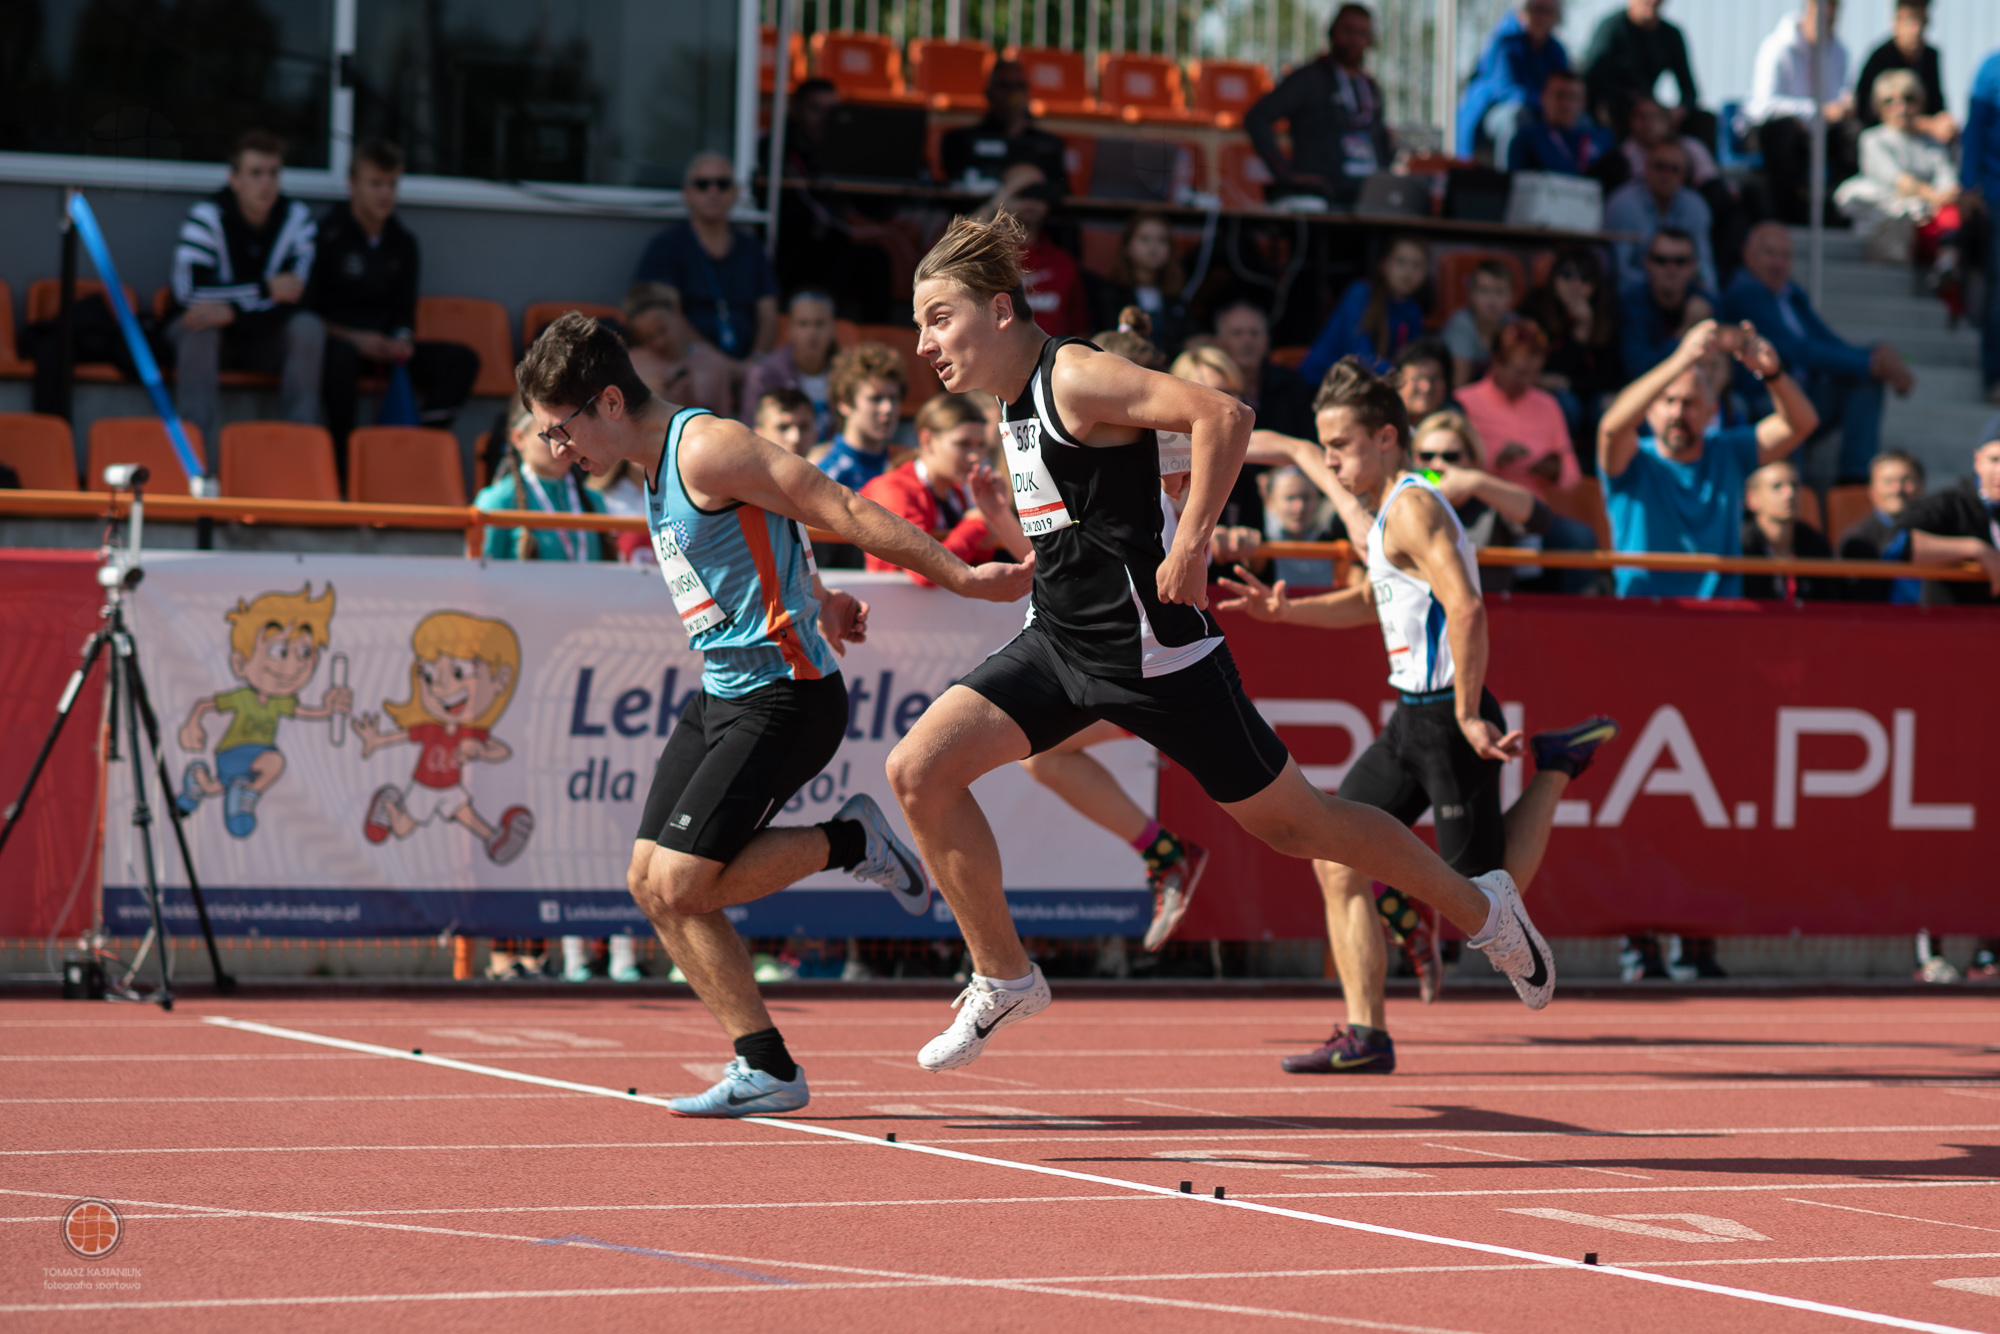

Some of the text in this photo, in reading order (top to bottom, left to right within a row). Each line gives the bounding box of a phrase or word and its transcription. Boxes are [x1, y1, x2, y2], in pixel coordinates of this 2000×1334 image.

[1017, 424, 1036, 451] 533
[1033, 517, 1053, 532] 2019
[670, 570, 700, 598] OWSKI
[693, 615, 710, 630] 2019
[1252, 698, 1976, 830] PLA.PL
[568, 757, 637, 802] dla
